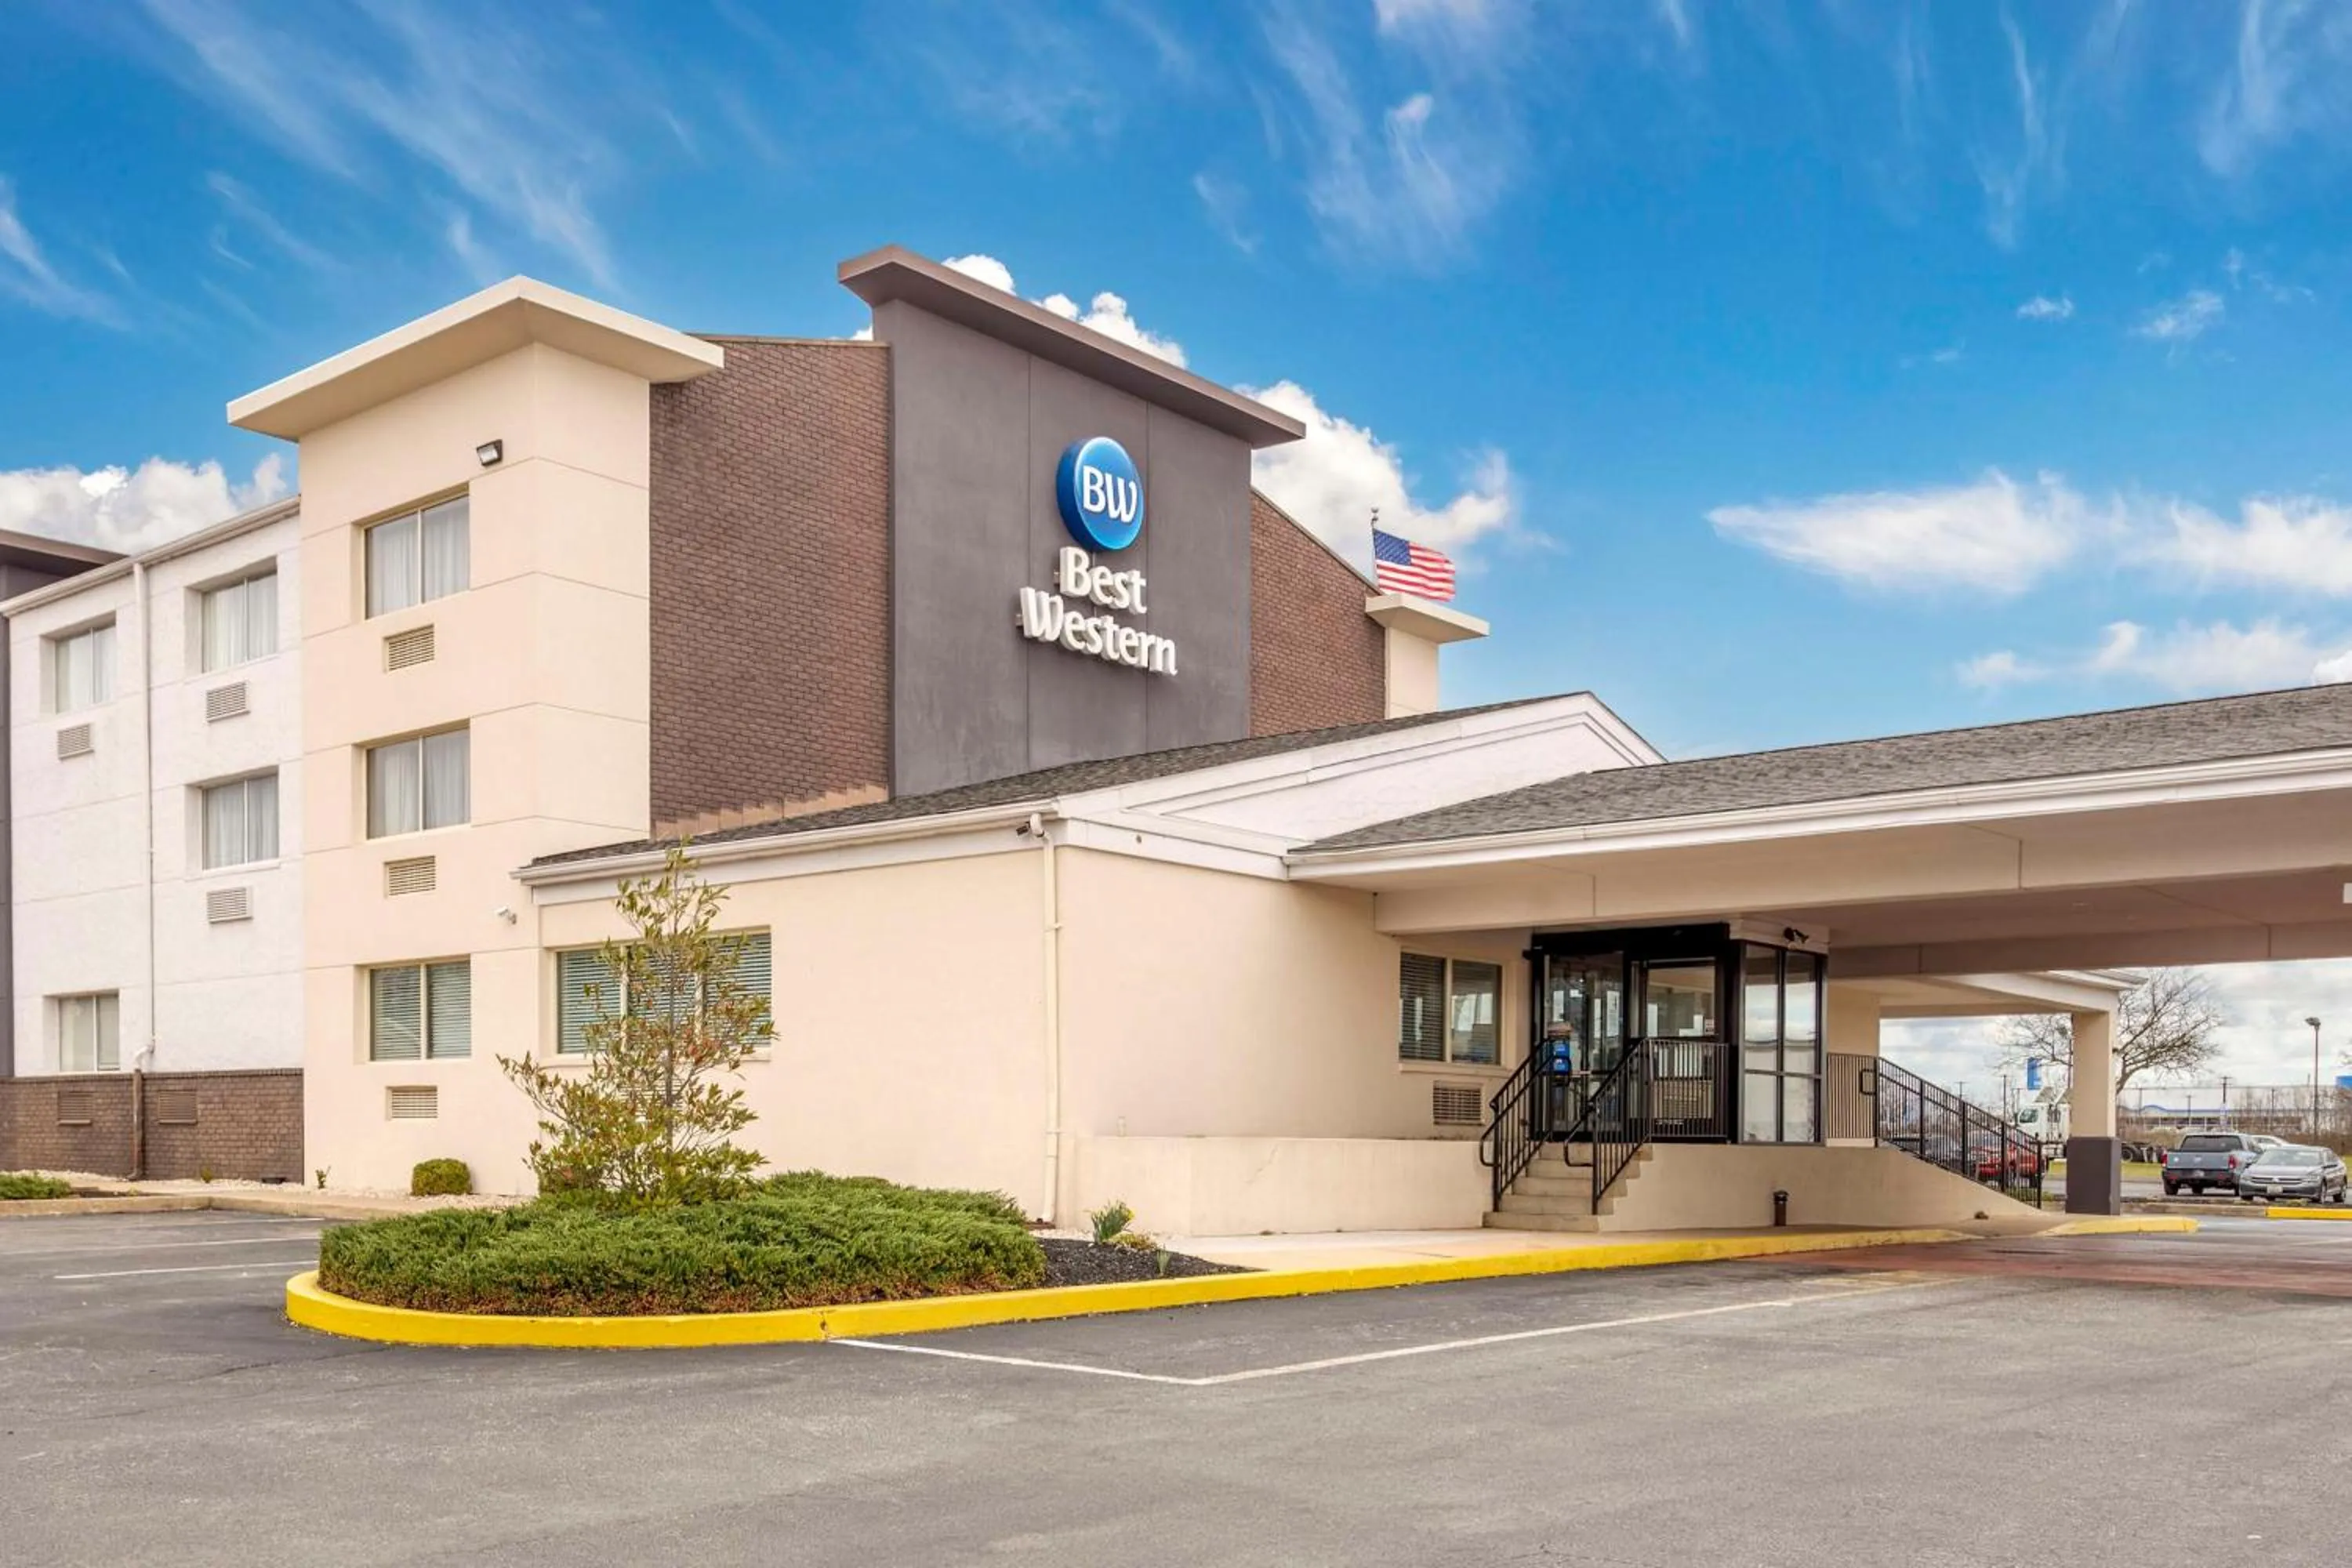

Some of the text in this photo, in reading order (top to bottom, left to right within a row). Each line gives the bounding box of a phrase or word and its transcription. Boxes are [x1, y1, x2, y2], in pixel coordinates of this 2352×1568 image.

[1083, 466, 1137, 523] BW
[1060, 546, 1147, 614] Best
[1020, 586, 1178, 675] Western
